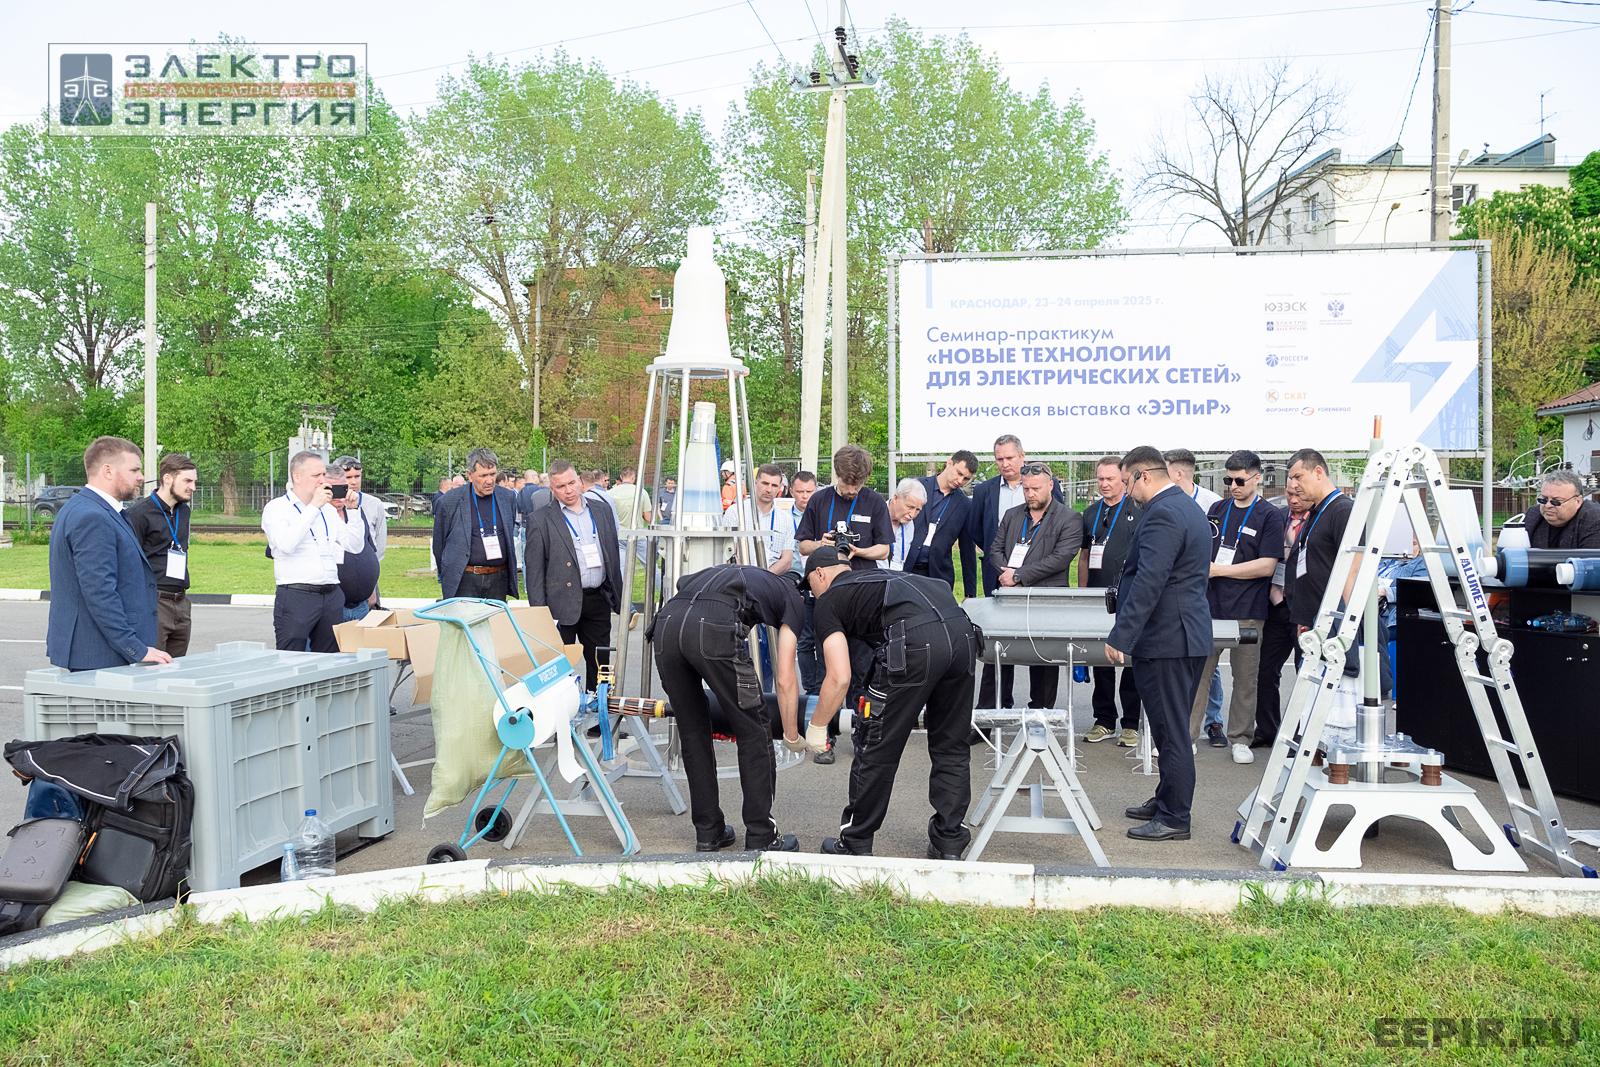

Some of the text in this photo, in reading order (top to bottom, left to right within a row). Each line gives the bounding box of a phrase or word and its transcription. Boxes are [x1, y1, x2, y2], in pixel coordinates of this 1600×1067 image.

[1074, 298, 1119, 308] апреля
[1123, 295, 1152, 306] 2025
[1264, 302, 1307, 312] ЮЗЭСК
[926, 327, 1114, 345] Семинар-практикум
[927, 345, 1171, 364] «НОВЫЕ ТЕХНОЛОГИИ
[926, 363, 1241, 390] ДЛЯ ЭЛЕКТРИЧЕСКИХ СЕТЕЙ»
[926, 399, 1231, 418] Техническая выставка «ЭЭПиР»
